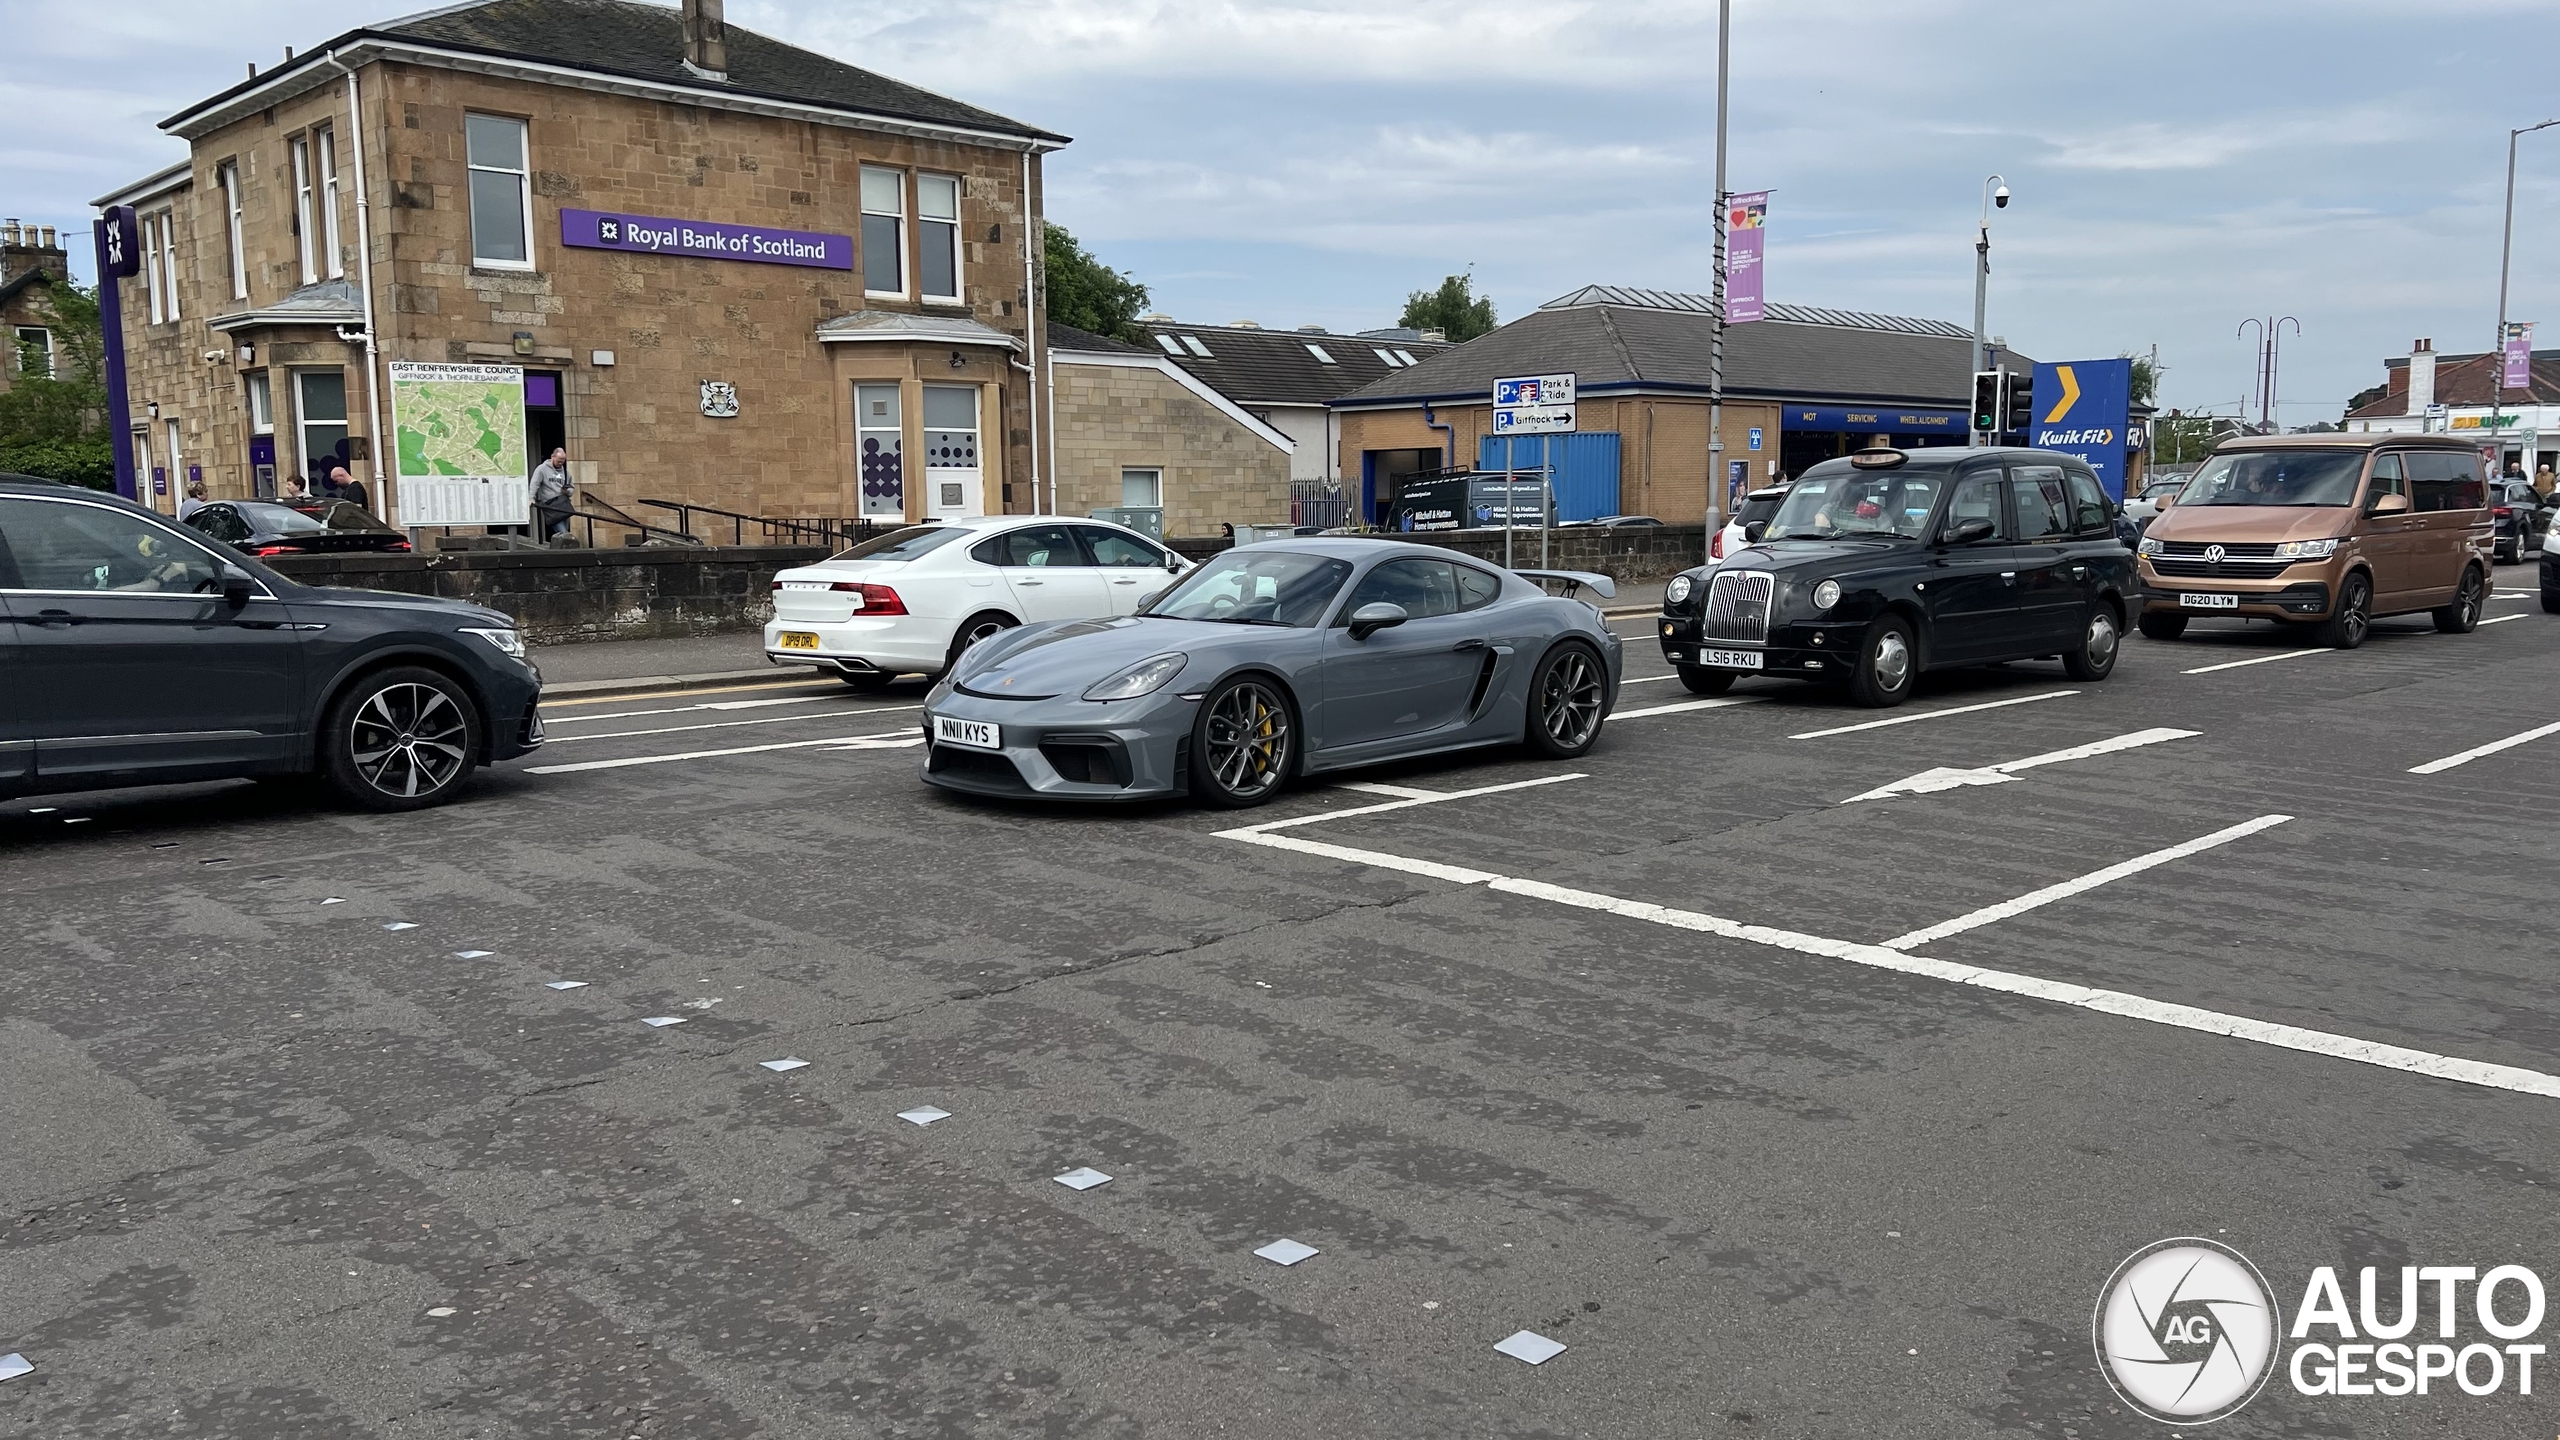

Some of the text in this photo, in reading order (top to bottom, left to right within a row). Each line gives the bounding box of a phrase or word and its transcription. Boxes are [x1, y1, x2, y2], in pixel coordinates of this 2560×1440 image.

[627, 223, 826, 259] Royal Bank of Scotland
[392, 363, 521, 374] EAST RENFREWSHIRE COUNCIL
[1542, 378, 1570, 388] Park &
[1803, 412, 1817, 421] MOT
[1847, 413, 1877, 423] SERVICING
[1900, 415, 1948, 425] WHEEL ALIGNMENT
[2038, 429, 2106, 446] Kwik Fit
[2184, 594, 2233, 606] DG20 LYW
[1706, 650, 1756, 666] LS16 RKU
[942, 719, 989, 743] NN11 KYS
